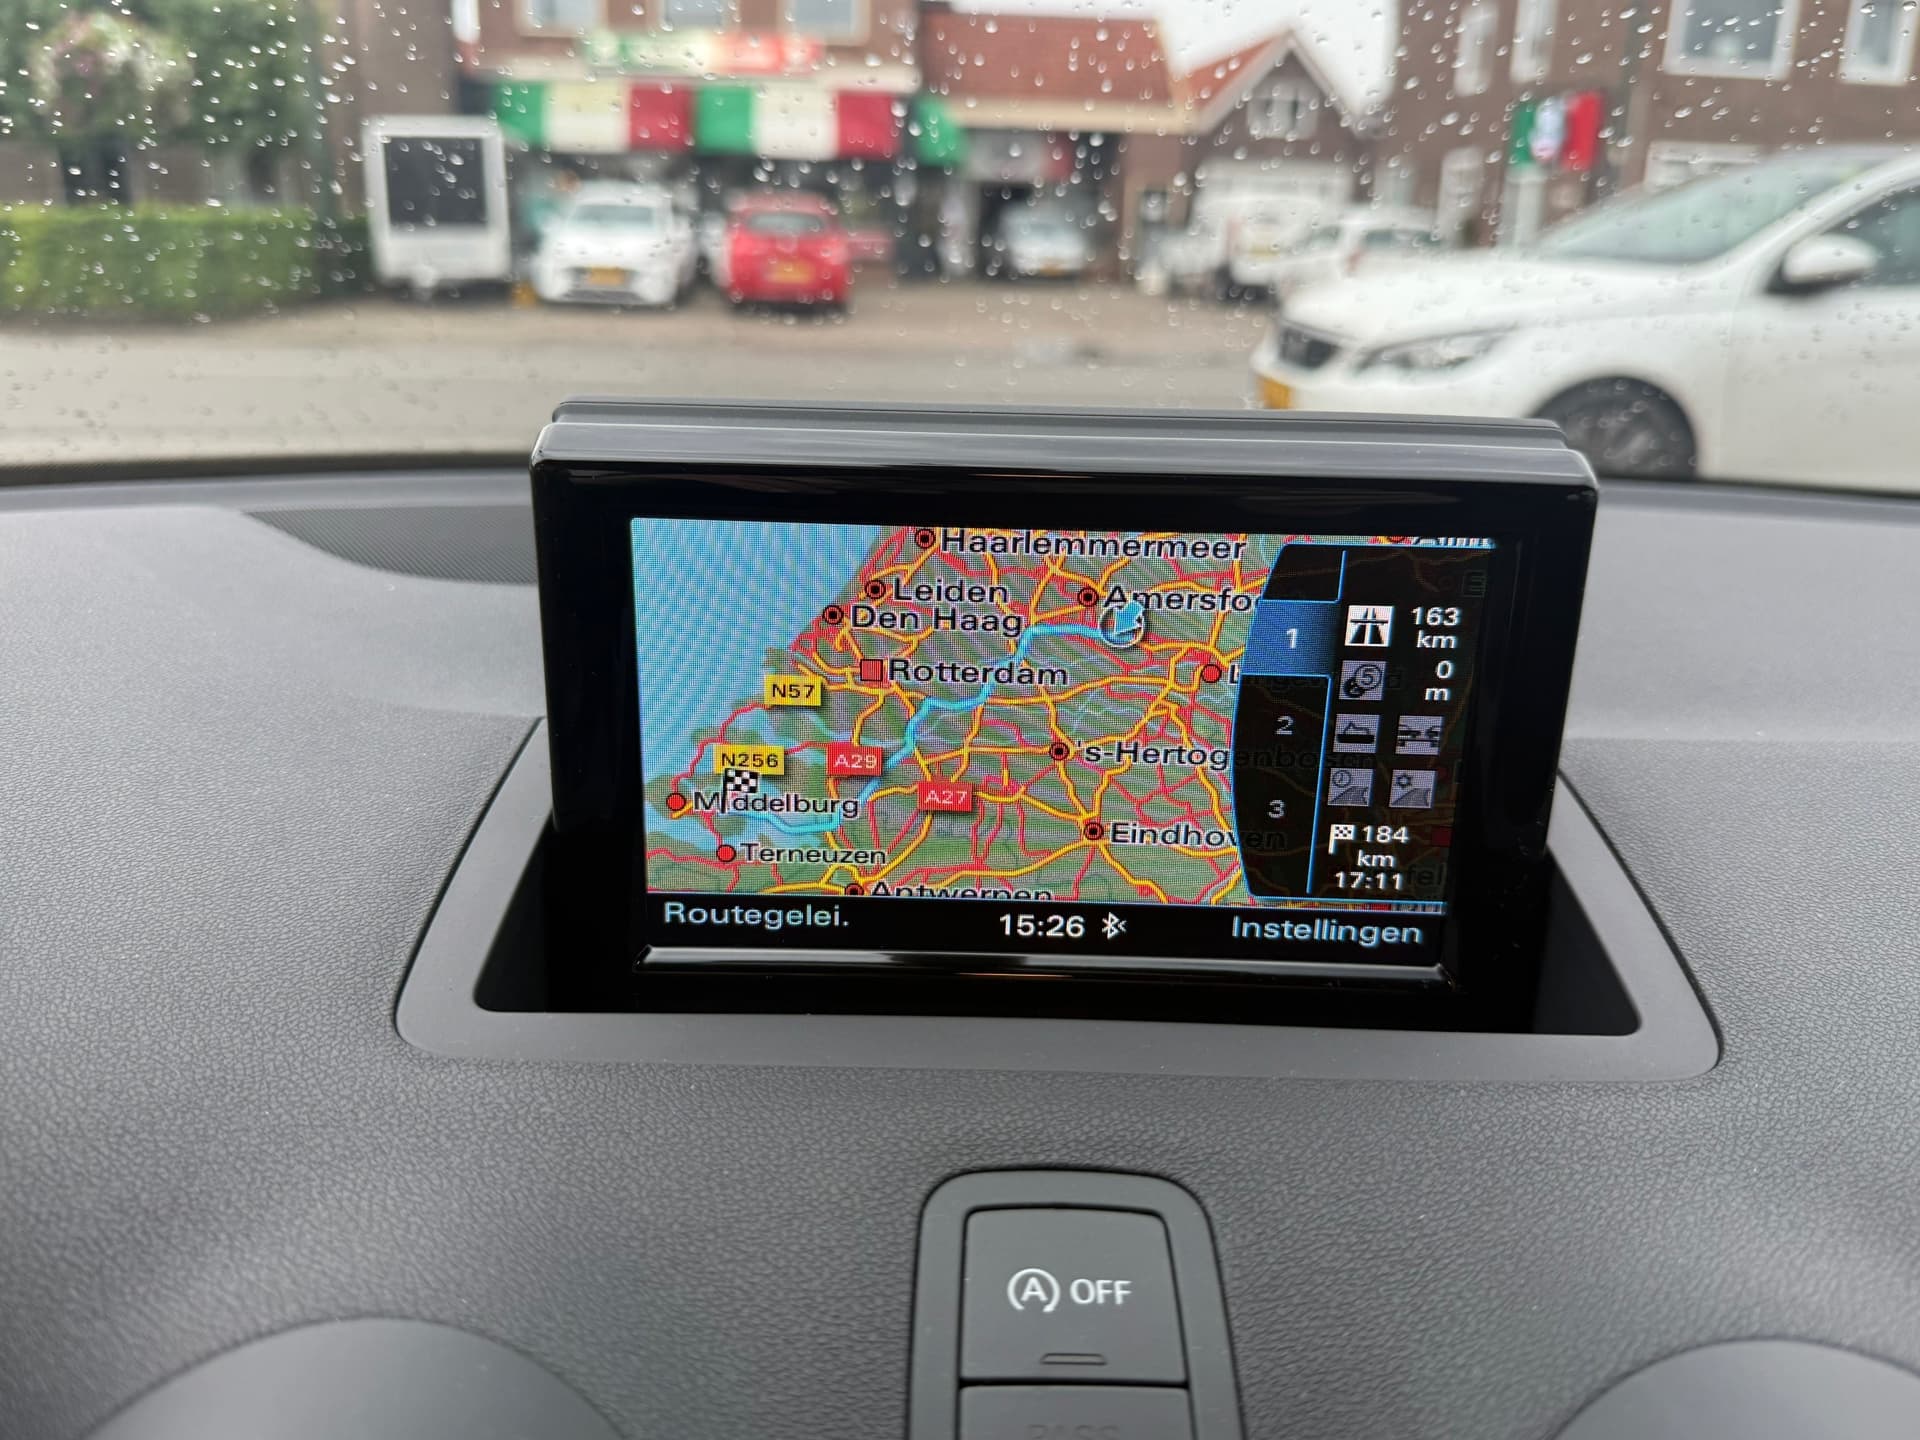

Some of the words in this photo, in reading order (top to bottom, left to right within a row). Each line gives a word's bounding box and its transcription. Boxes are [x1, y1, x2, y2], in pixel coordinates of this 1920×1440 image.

[941, 529, 1246, 560] Haarlemmermeer
[893, 579, 1008, 603] Leiden
[1104, 585, 1258, 612] Amersfo
[850, 605, 919, 630] Den
[932, 606, 1024, 637] Haag
[1411, 606, 1461, 627] 163
[1286, 627, 1298, 649] 1
[1416, 629, 1458, 650] km
[889, 659, 1068, 686] Rotterdam
[1434, 660, 1451, 680] 0
[770, 683, 816, 699] N57
[1424, 686, 1450, 702] m
[1274, 715, 1294, 735] 2
[720, 752, 780, 768] N256
[834, 754, 878, 769] A29
[693, 791, 859, 819] Mddelburg
[925, 789, 967, 805] A27
[1267, 800, 1286, 819] 3
[1360, 826, 1410, 844] 184
[739, 842, 886, 864] Terneuzen
[1356, 849, 1396, 869] km
[1334, 870, 1404, 890] 17:11
[664, 901, 849, 929] Routegelei.
[1000, 913, 1085, 937] 15:26
[1231, 915, 1424, 947] Instellingen
[1069, 1278, 1132, 1305] OFF
